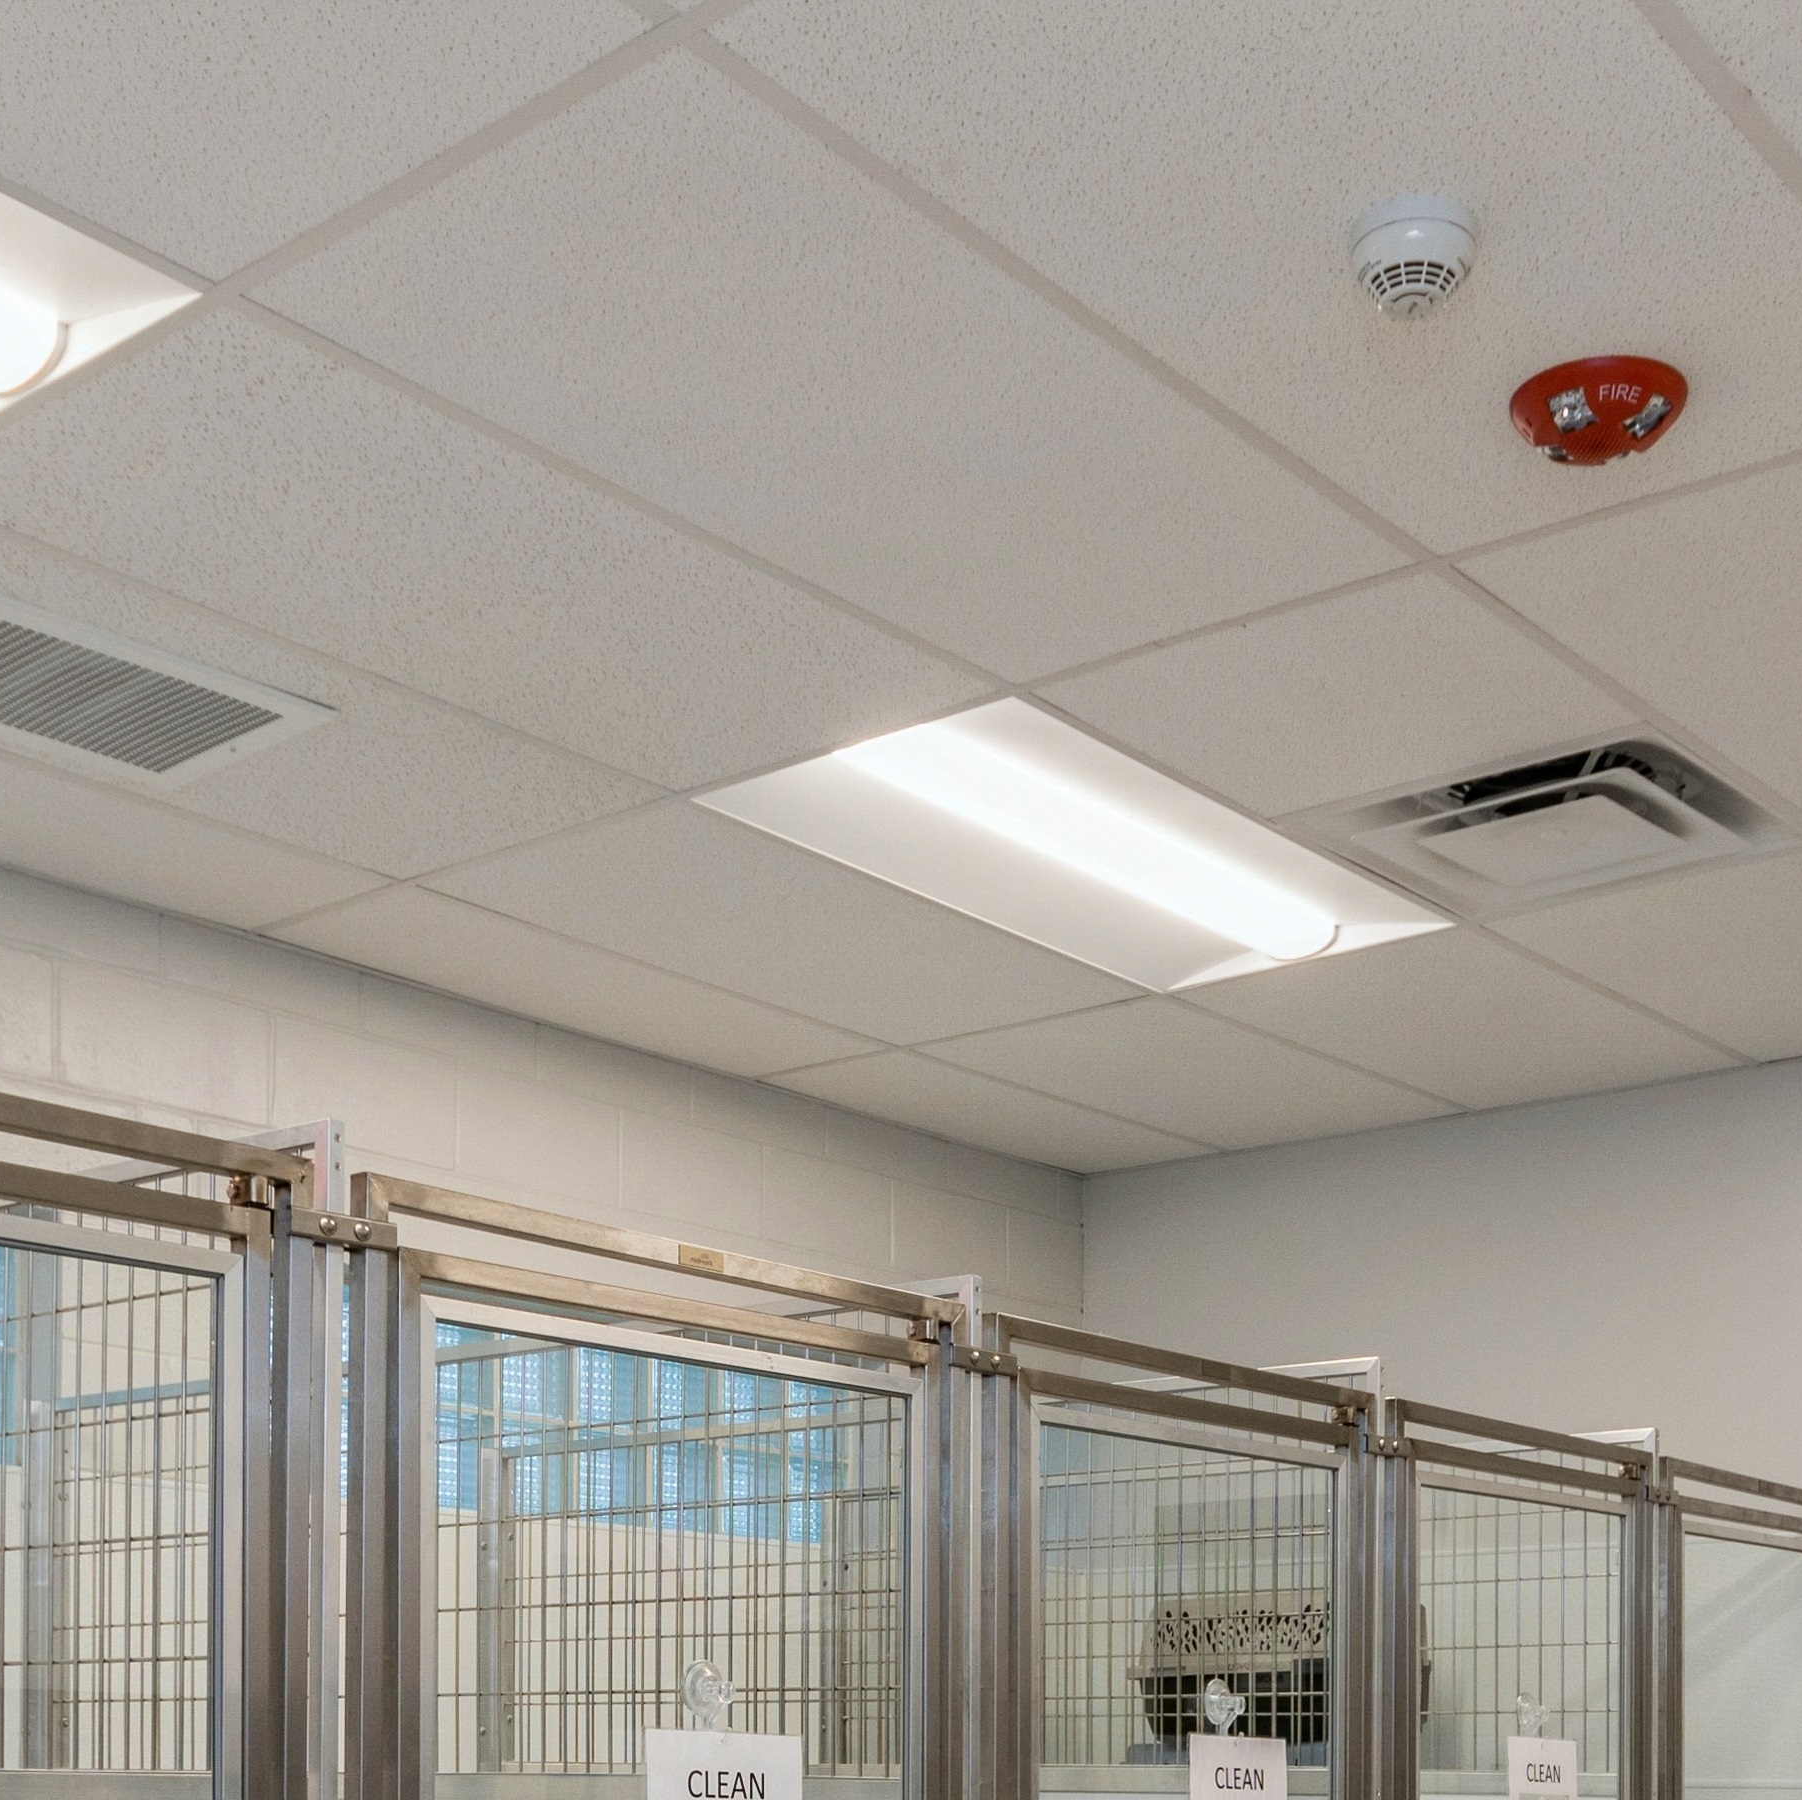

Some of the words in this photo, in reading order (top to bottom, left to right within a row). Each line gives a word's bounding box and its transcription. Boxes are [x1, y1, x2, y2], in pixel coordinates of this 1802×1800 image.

[1599, 383, 1642, 405] FIRE
[687, 1769, 766, 1800] CLEAN
[1214, 1766, 1265, 1791] CLEAN
[1526, 1762, 1561, 1784] CLEAN
